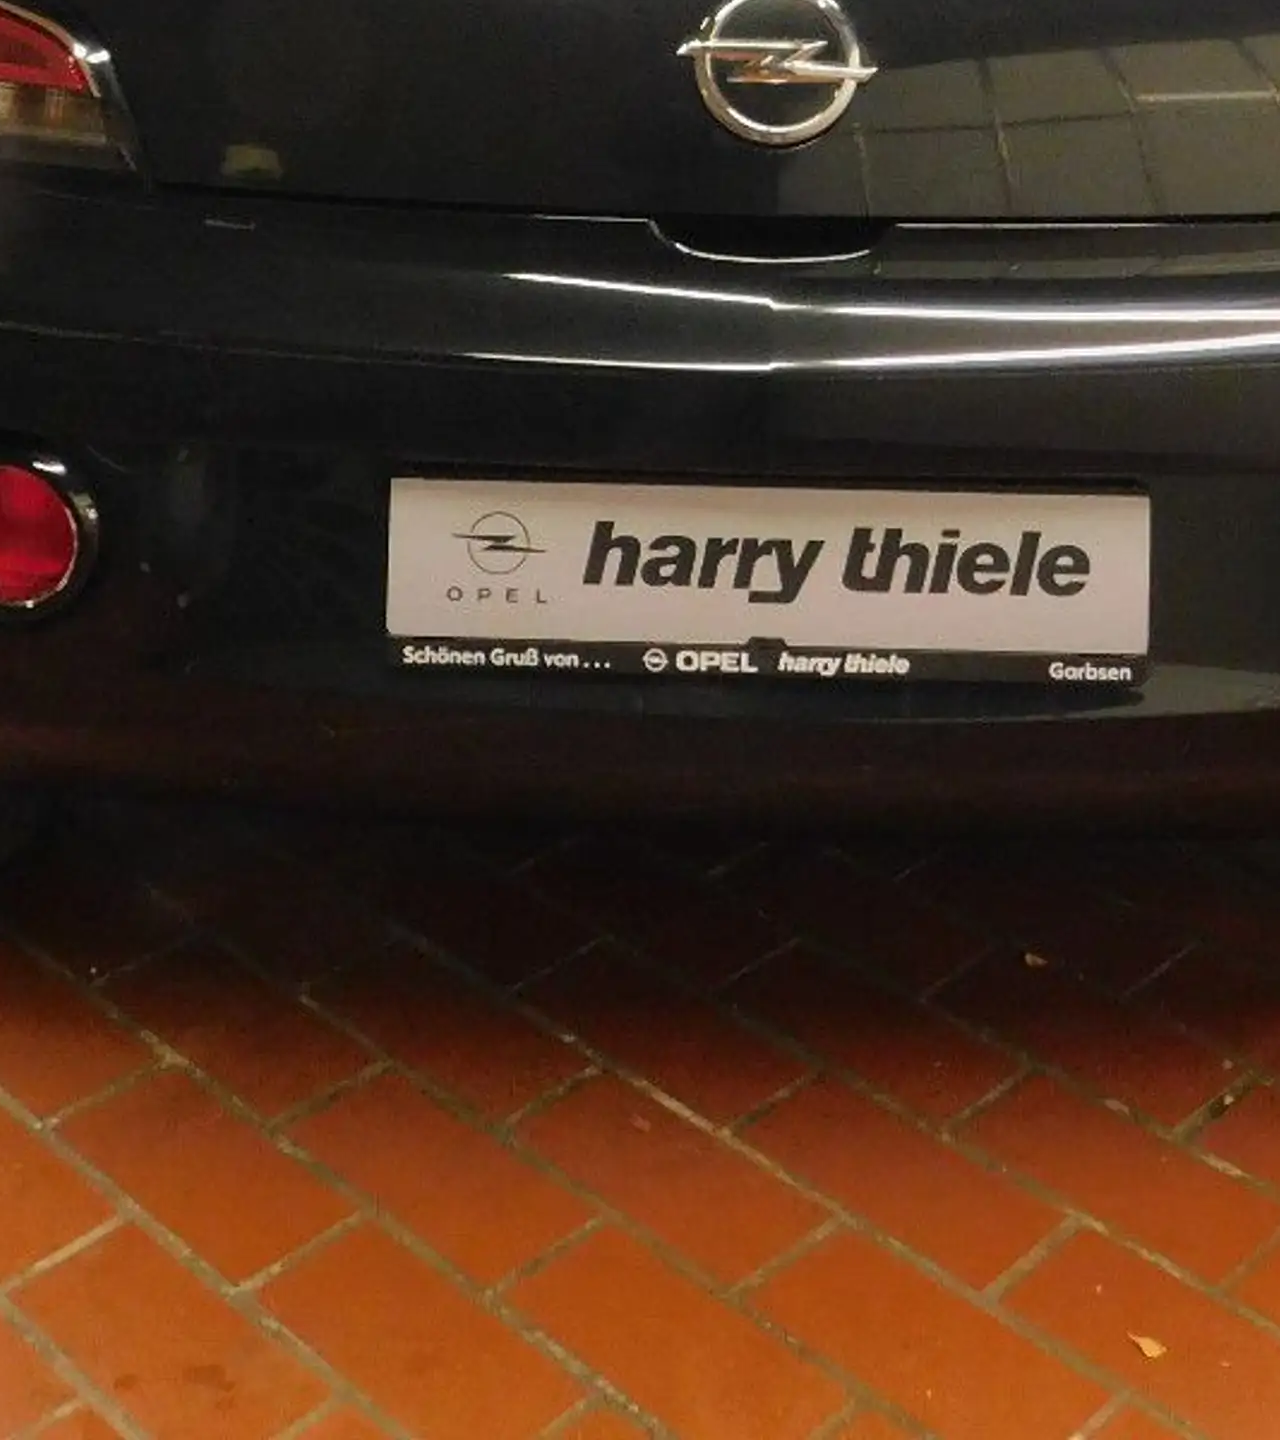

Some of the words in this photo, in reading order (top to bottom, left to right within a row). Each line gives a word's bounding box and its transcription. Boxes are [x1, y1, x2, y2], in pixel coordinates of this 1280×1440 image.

[582, 521, 825, 604] harry
[841, 527, 1091, 596] thiele
[446, 586, 548, 604] OPEL
[402, 646, 486, 666] Schönen
[490, 648, 539, 667] Gruß
[675, 650, 758, 673] OPEL
[777, 651, 842, 677] harry
[844, 652, 911, 674] thiele
[1048, 662, 1132, 682] Garbsen
